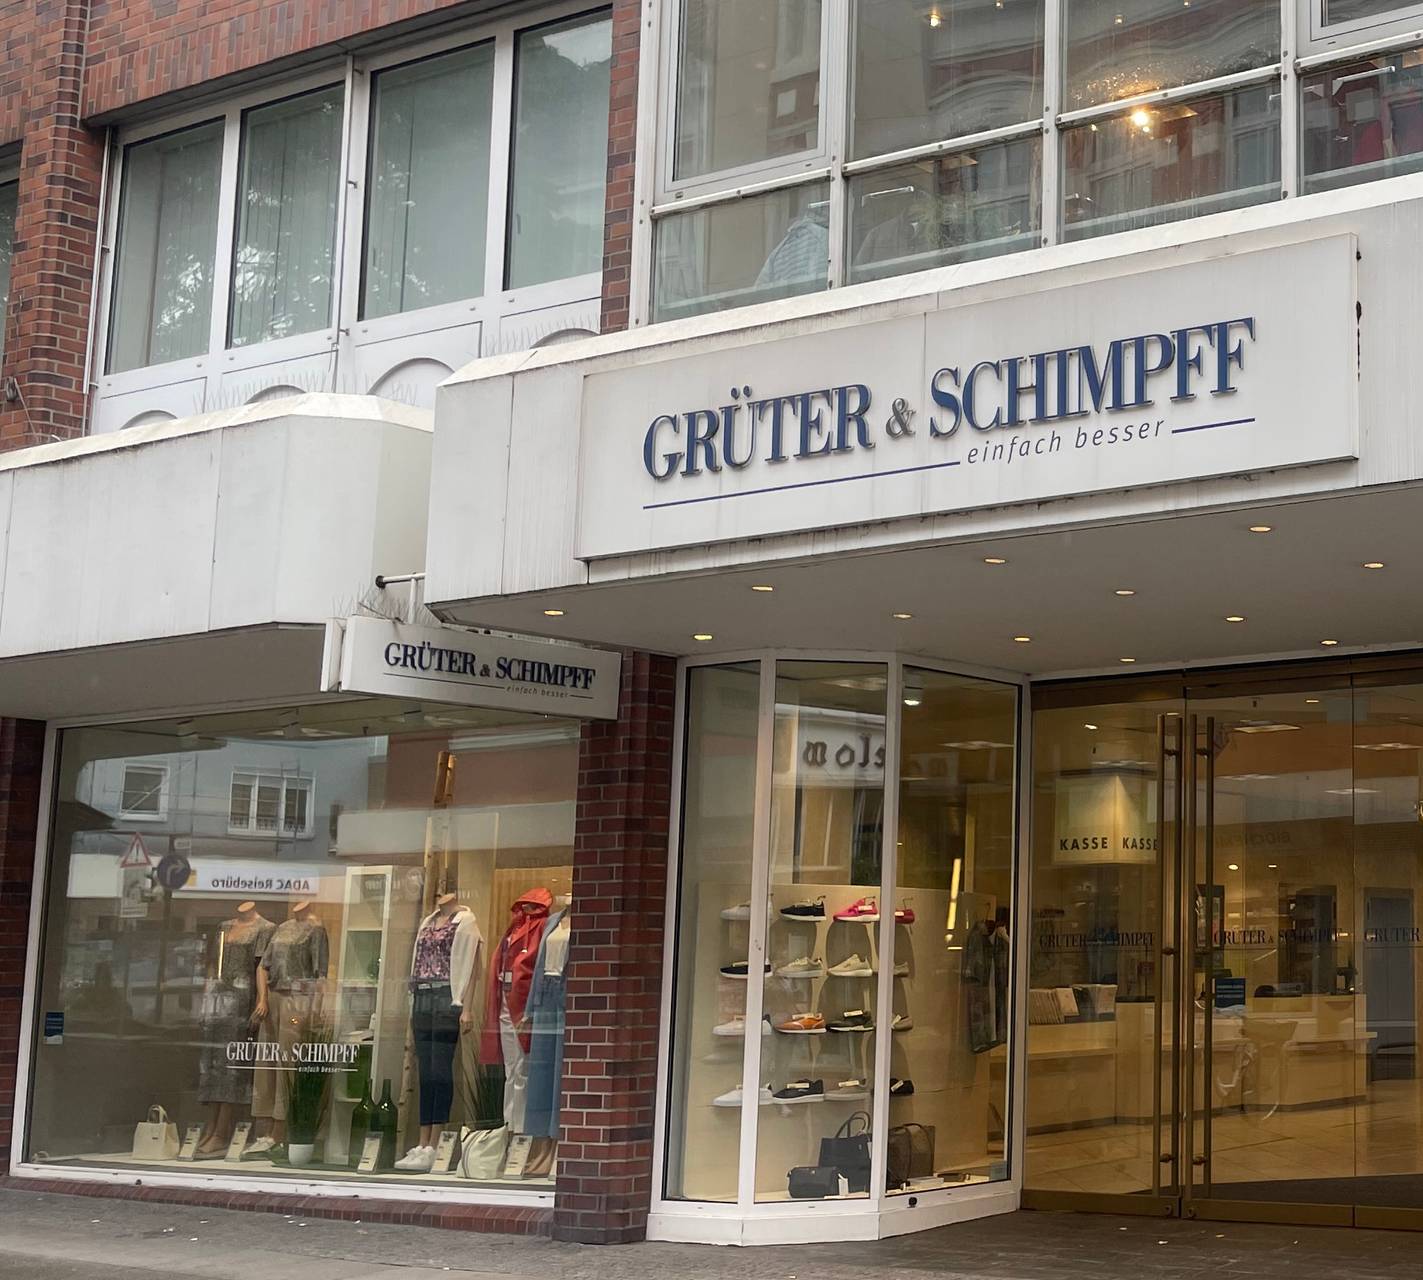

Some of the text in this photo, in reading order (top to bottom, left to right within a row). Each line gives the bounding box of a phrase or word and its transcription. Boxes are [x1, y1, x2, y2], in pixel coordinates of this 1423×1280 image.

[642, 316, 1257, 482] GRÜTER & SCHIMPFF
[966, 416, 1167, 466] einfach besser
[384, 641, 597, 690] GRÜTER & SCHIMPFF
[506, 686, 569, 699] einfach besser
[1060, 837, 1108, 850] KASSE
[1122, 837, 1158, 850] KASSE
[226, 1036, 280, 1062] GRÜTER
[291, 1042, 360, 1064] SCHIMPFF
